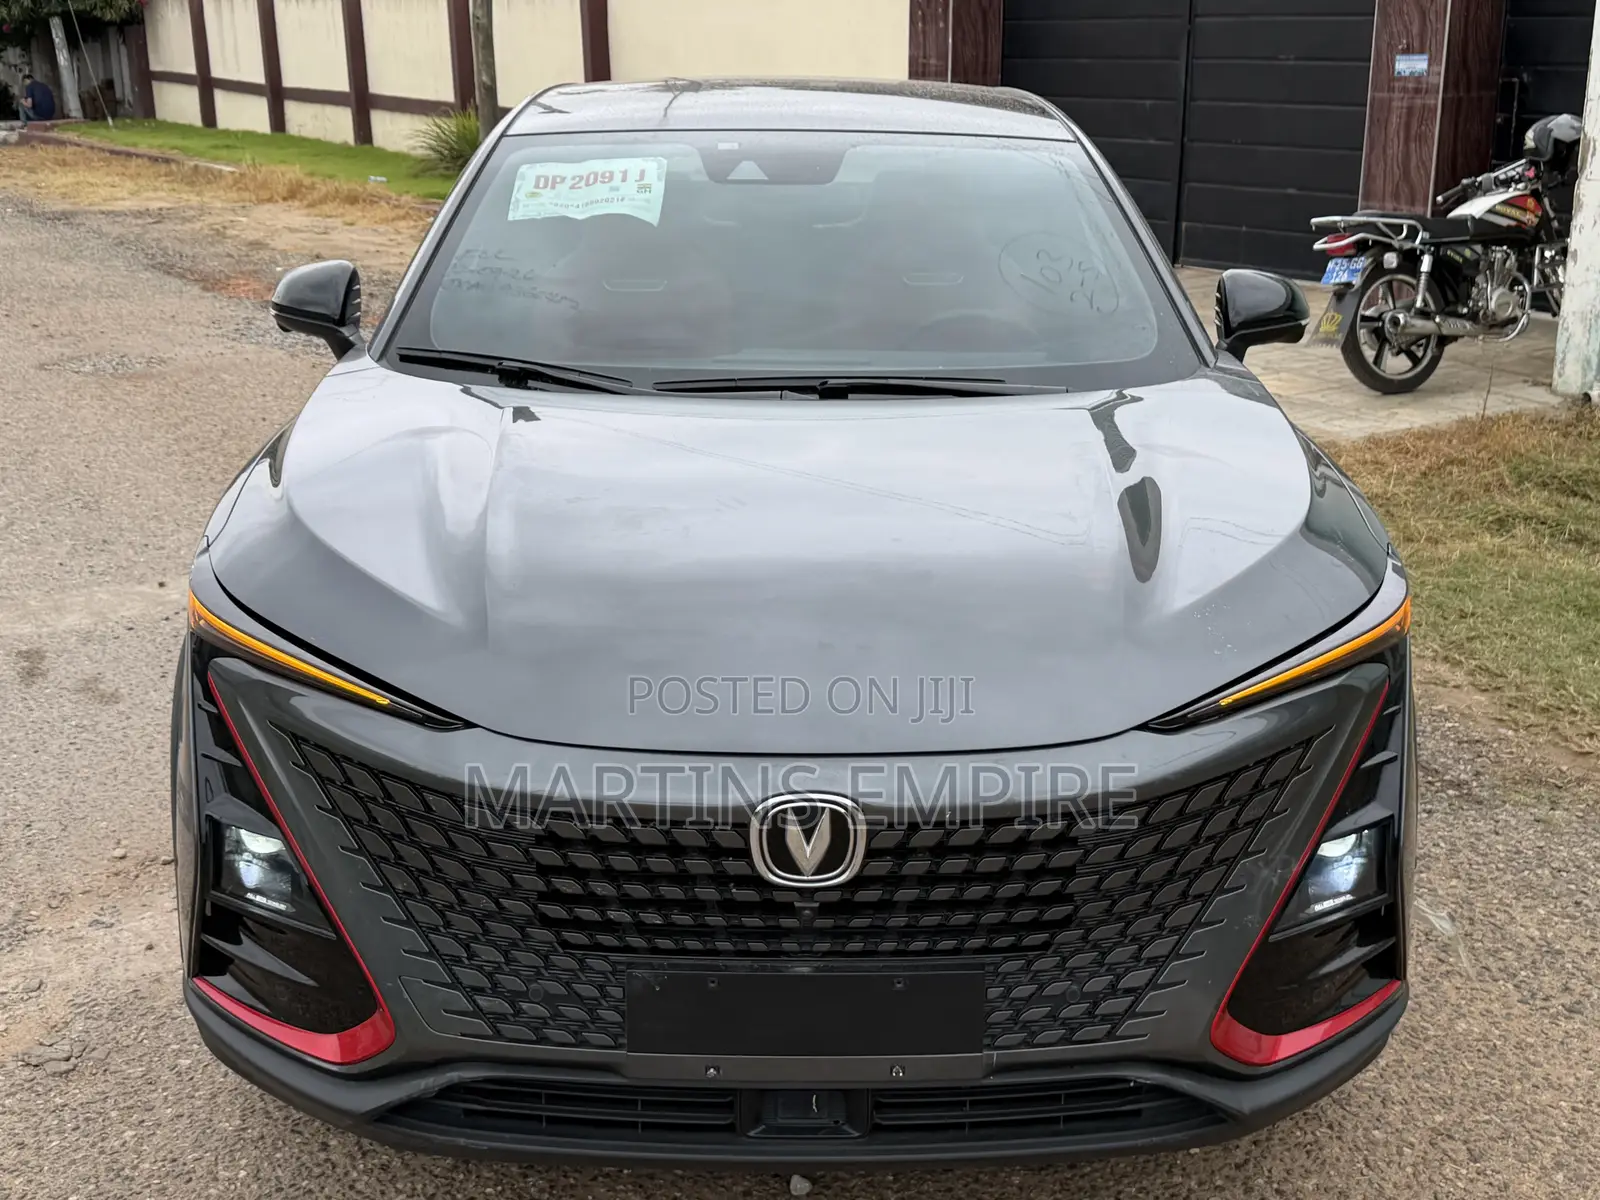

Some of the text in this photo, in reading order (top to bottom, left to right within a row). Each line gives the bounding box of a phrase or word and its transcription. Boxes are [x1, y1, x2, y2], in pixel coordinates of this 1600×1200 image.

[533, 174, 566, 190] DP
[568, 169, 628, 190] 2091
[635, 168, 646, 183] J
